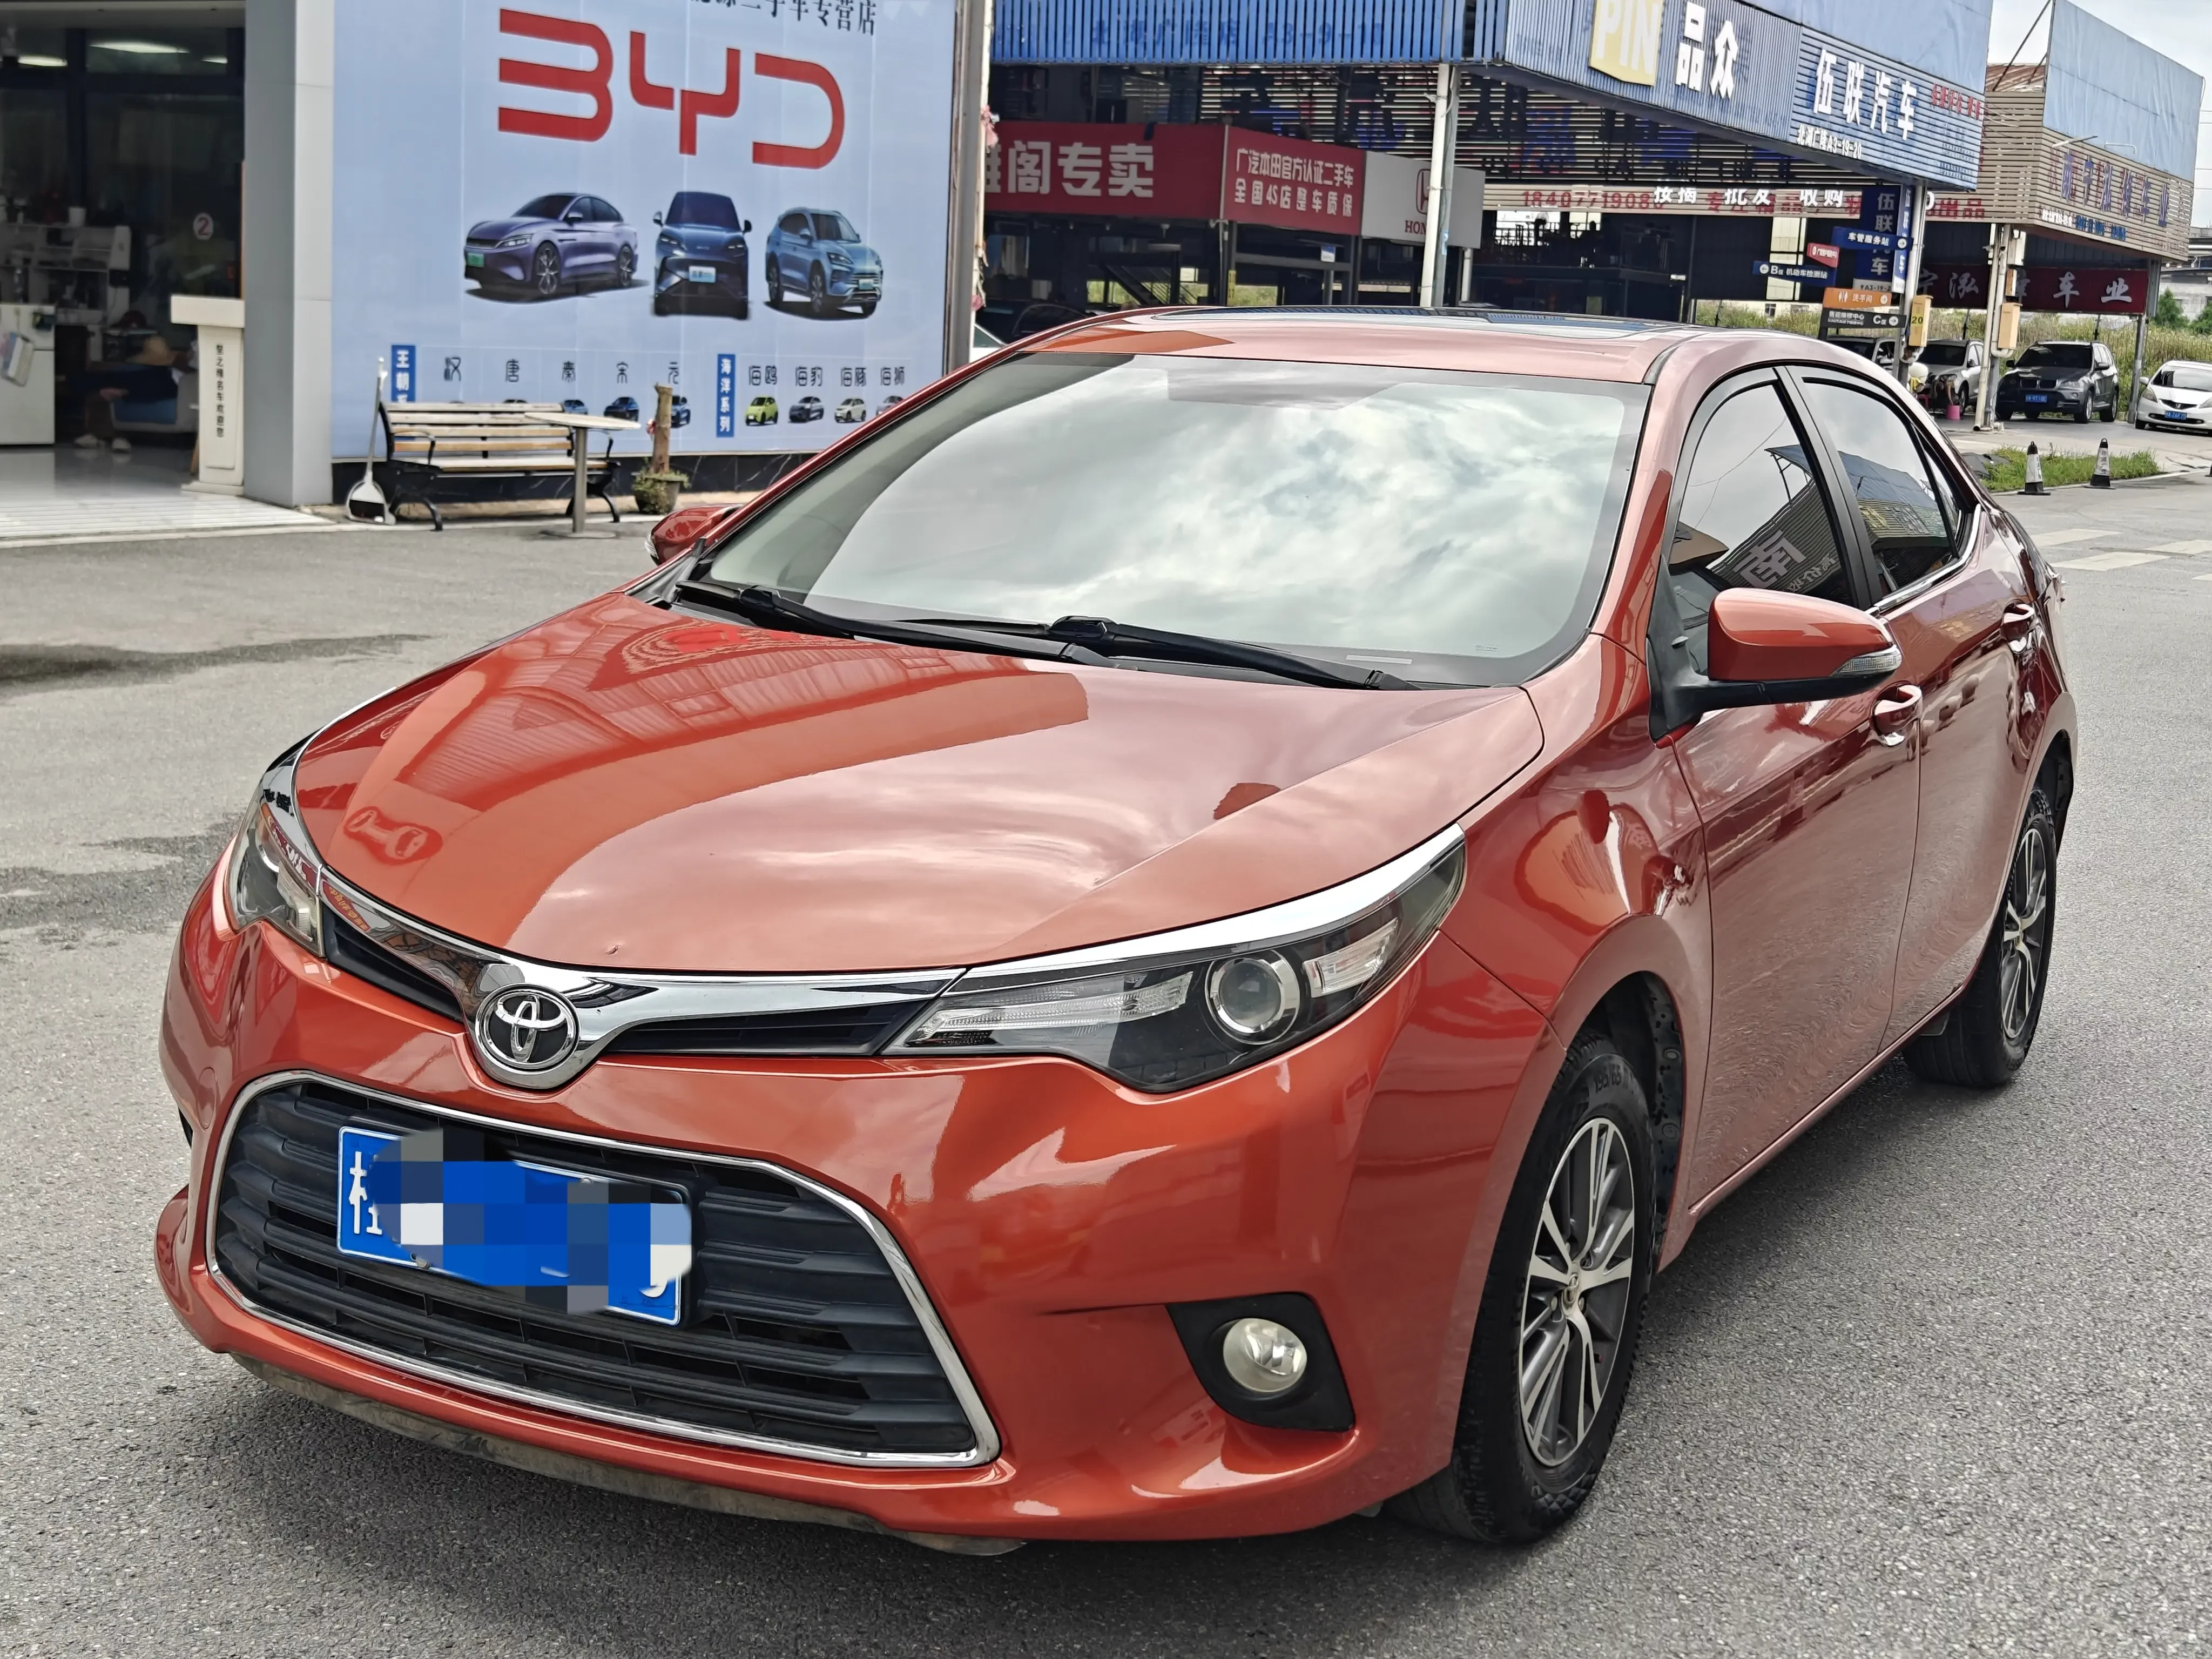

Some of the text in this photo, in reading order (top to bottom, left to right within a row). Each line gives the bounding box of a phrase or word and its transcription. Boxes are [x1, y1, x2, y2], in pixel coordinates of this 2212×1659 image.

[1675, 1, 1738, 100] 品众
[498, 8, 845, 170] BYD
[1813, 49, 1917, 141] 伍联汽车
[1236, 148, 1354, 188] 广汽本田官方认证二手车
[1235, 178, 1352, 217] 全国4S店整车质保
[198, 218, 210, 235] 2
[1405, 221, 1427, 234] HON
[1848, 232, 1889, 246] 车管服务站
[1871, 193, 1896, 275] 伍联车
[505, 359, 519, 382] 唐
[668, 362, 679, 384] 元
